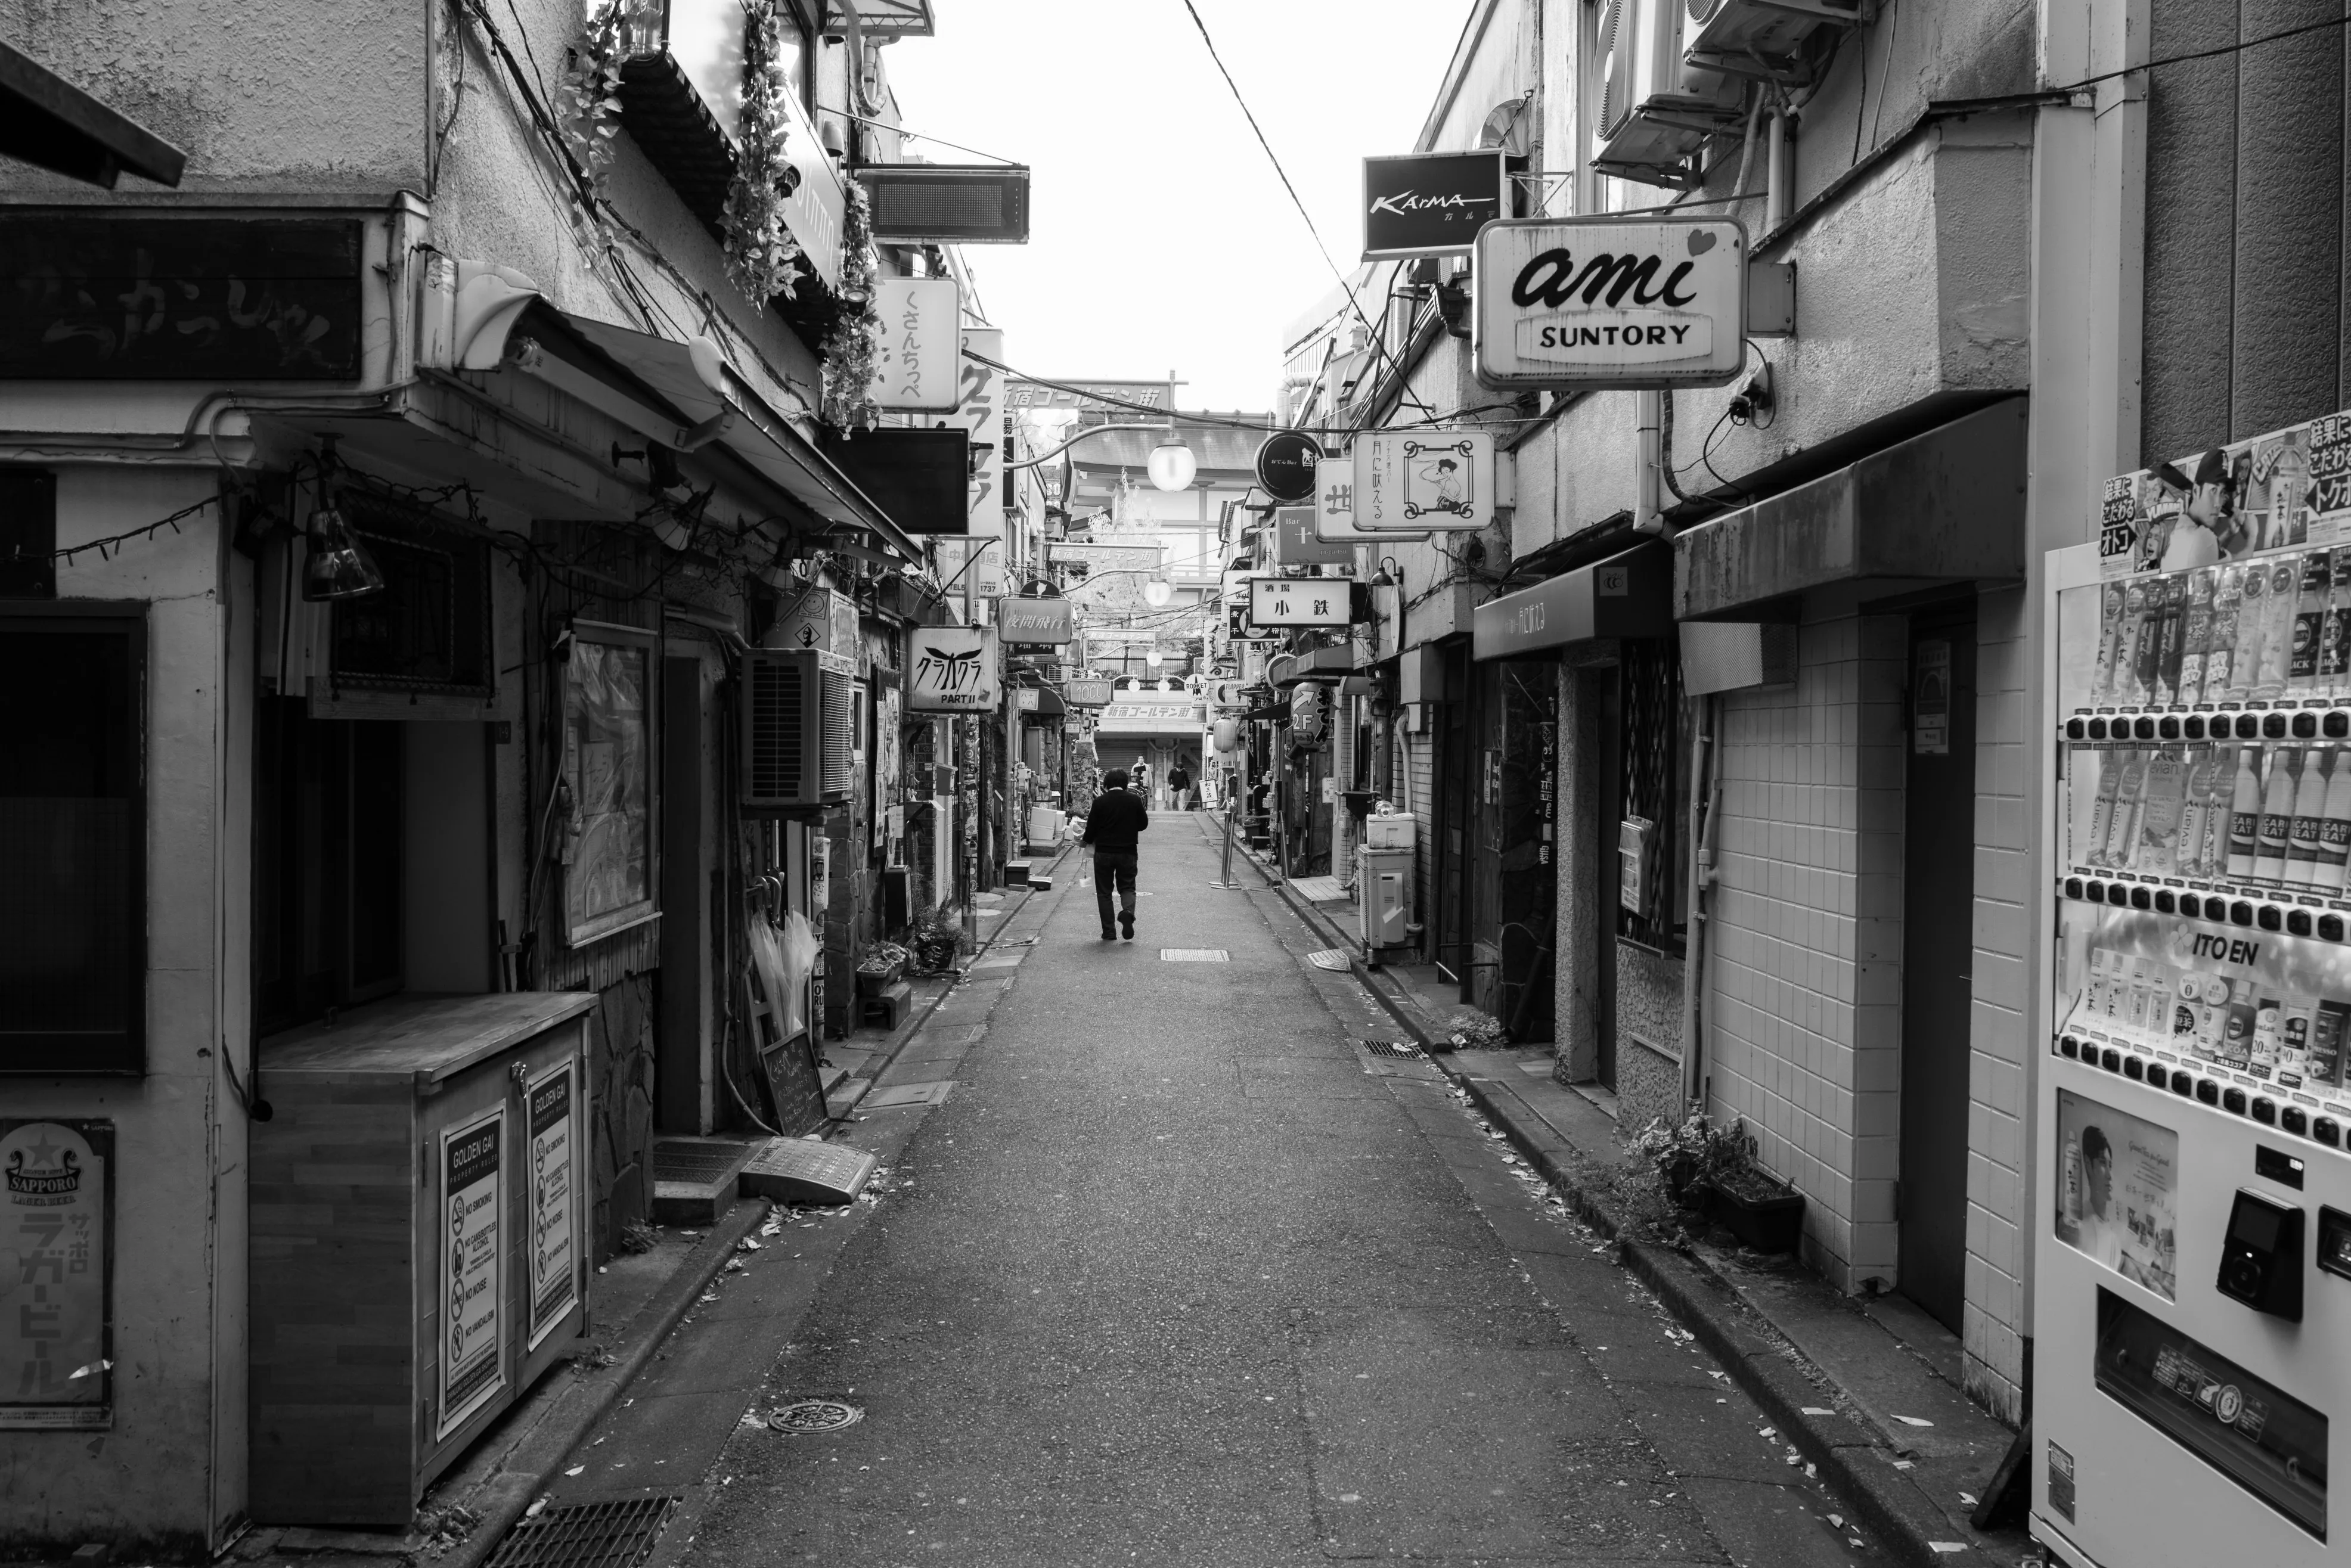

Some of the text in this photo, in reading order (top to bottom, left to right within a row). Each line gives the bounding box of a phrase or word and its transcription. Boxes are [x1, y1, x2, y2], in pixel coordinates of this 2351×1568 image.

[1512, 248, 1697, 308] ami
[901, 291, 922, 398] くさんちっぺ
[1540, 325, 1691, 348] SUNTORY
[1373, 441, 1382, 519] 月に吠える
[1050, 548, 1153, 561] 新宿ゴールデン街
[2102, 529, 2129, 555] オトコ
[1265, 584, 1290, 592] 酒場
[1274, 600, 1329, 616] 小鉄
[1006, 616, 1066, 629] 夜間飛行
[941, 695, 967, 703] PART
[1108, 706, 1190, 718] 新宿ゴールデン街
[1293, 713, 1314, 730] 2F
[2150, 763, 2179, 775] evian
[2091, 803, 2101, 839] evian
[2109, 806, 2122, 841] evian
[2181, 807, 2194, 847] evian
[535, 1082, 566, 1113] GOLDEN GAI
[533, 1099, 568, 1129] PROPERTY RULES
[454, 1134, 494, 1168] GOLDEN GAI
[545, 1134, 565, 1155] NO SMOKING
[450, 1153, 498, 1185] PROPERTY RULES
[11, 1176, 75, 1192] SAPPORO
[11, 1195, 46, 1207] LAGER
[466, 1192, 492, 1216] NO SMOKING
[547, 1209, 563, 1230] NO NOISE
[68, 1213, 90, 1274] サッポロ
[465, 1221, 496, 1249] NO CANS/BOTTLES
[473, 1237, 489, 1252] ALCOHOL
[548, 1237, 569, 1263] NO VANDALISM
[466, 1278, 487, 1300] NO NOISE
[17, 1213, 66, 1395] ラガービール
[466, 1309, 494, 1337] NO VANDALISM
[463, 1372, 476, 1387] GOLDEN
[482, 1354, 496, 1371] SHOPPING
